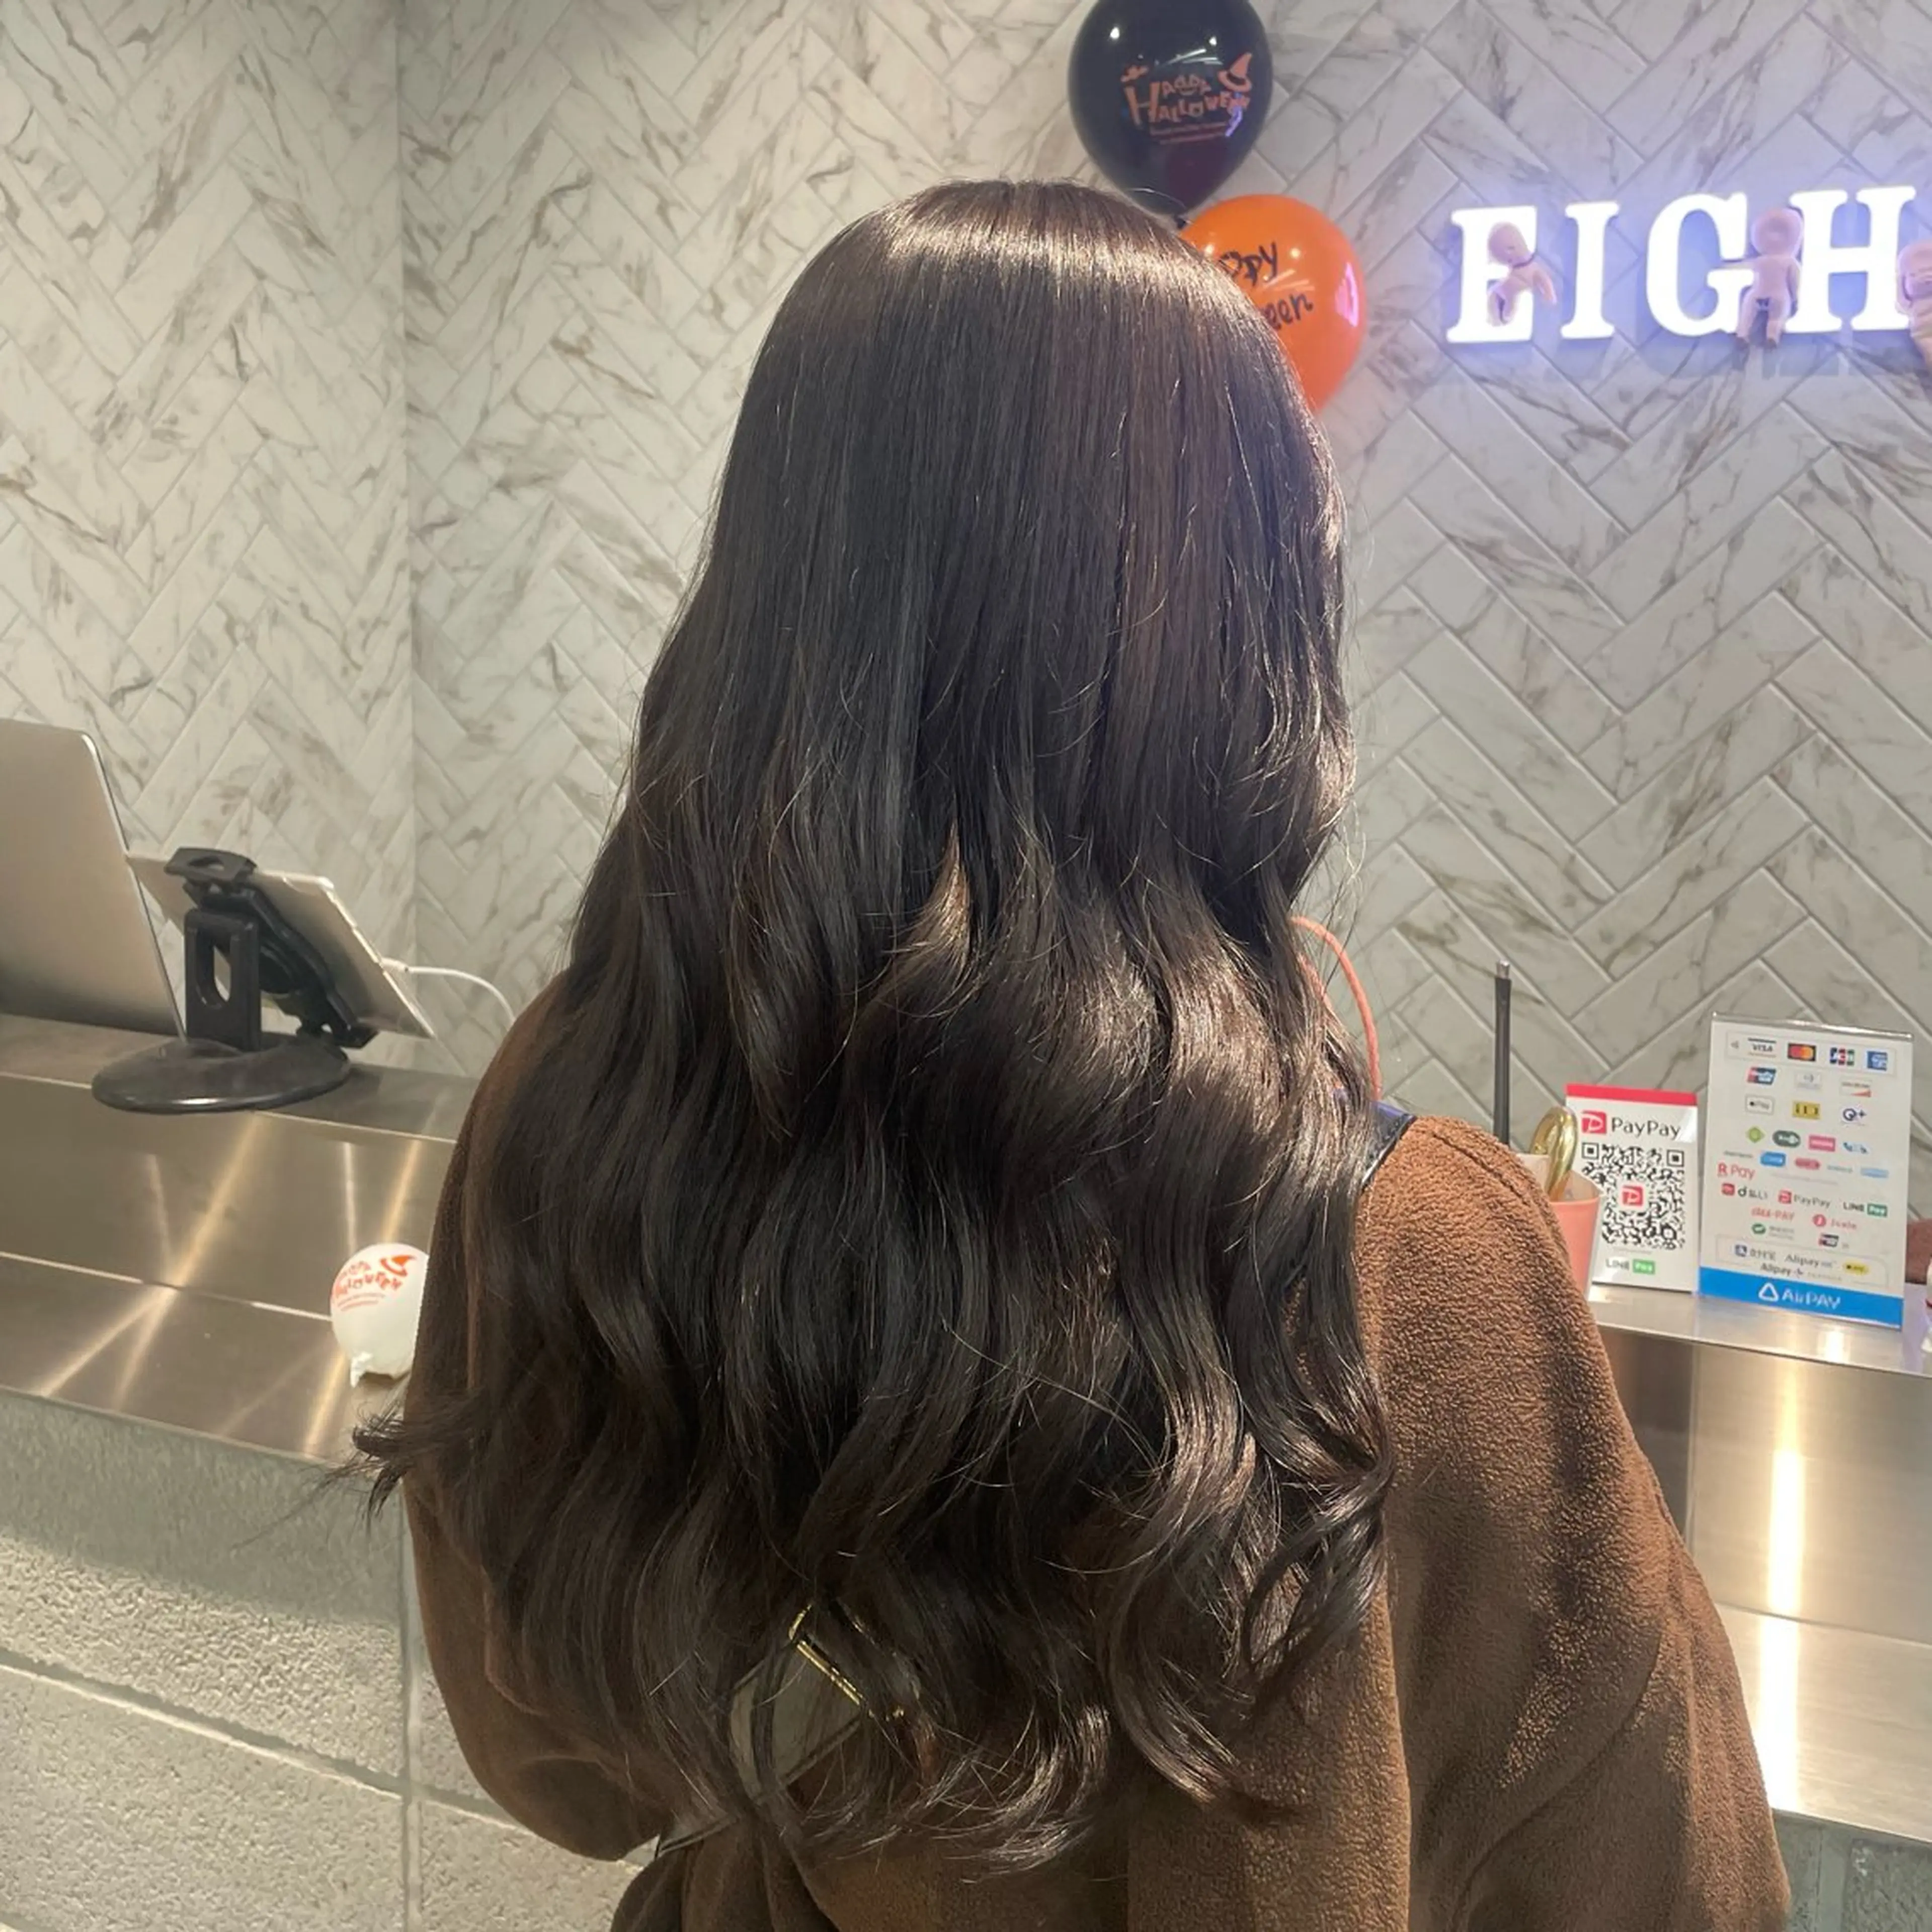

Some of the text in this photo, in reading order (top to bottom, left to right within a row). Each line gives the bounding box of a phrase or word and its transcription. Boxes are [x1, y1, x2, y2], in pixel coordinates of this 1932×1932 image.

[1218, 240, 1278, 286] ppy
[1263, 293, 1313, 330] een
[1611, 1116, 1680, 1140] PayPay
[1731, 1164, 1755, 1180] Pay
[1794, 1194, 1831, 1209] PayPay
[1785, 1254, 1819, 1268] Alipay
[1782, 1288, 1841, 1310] AirPAY
